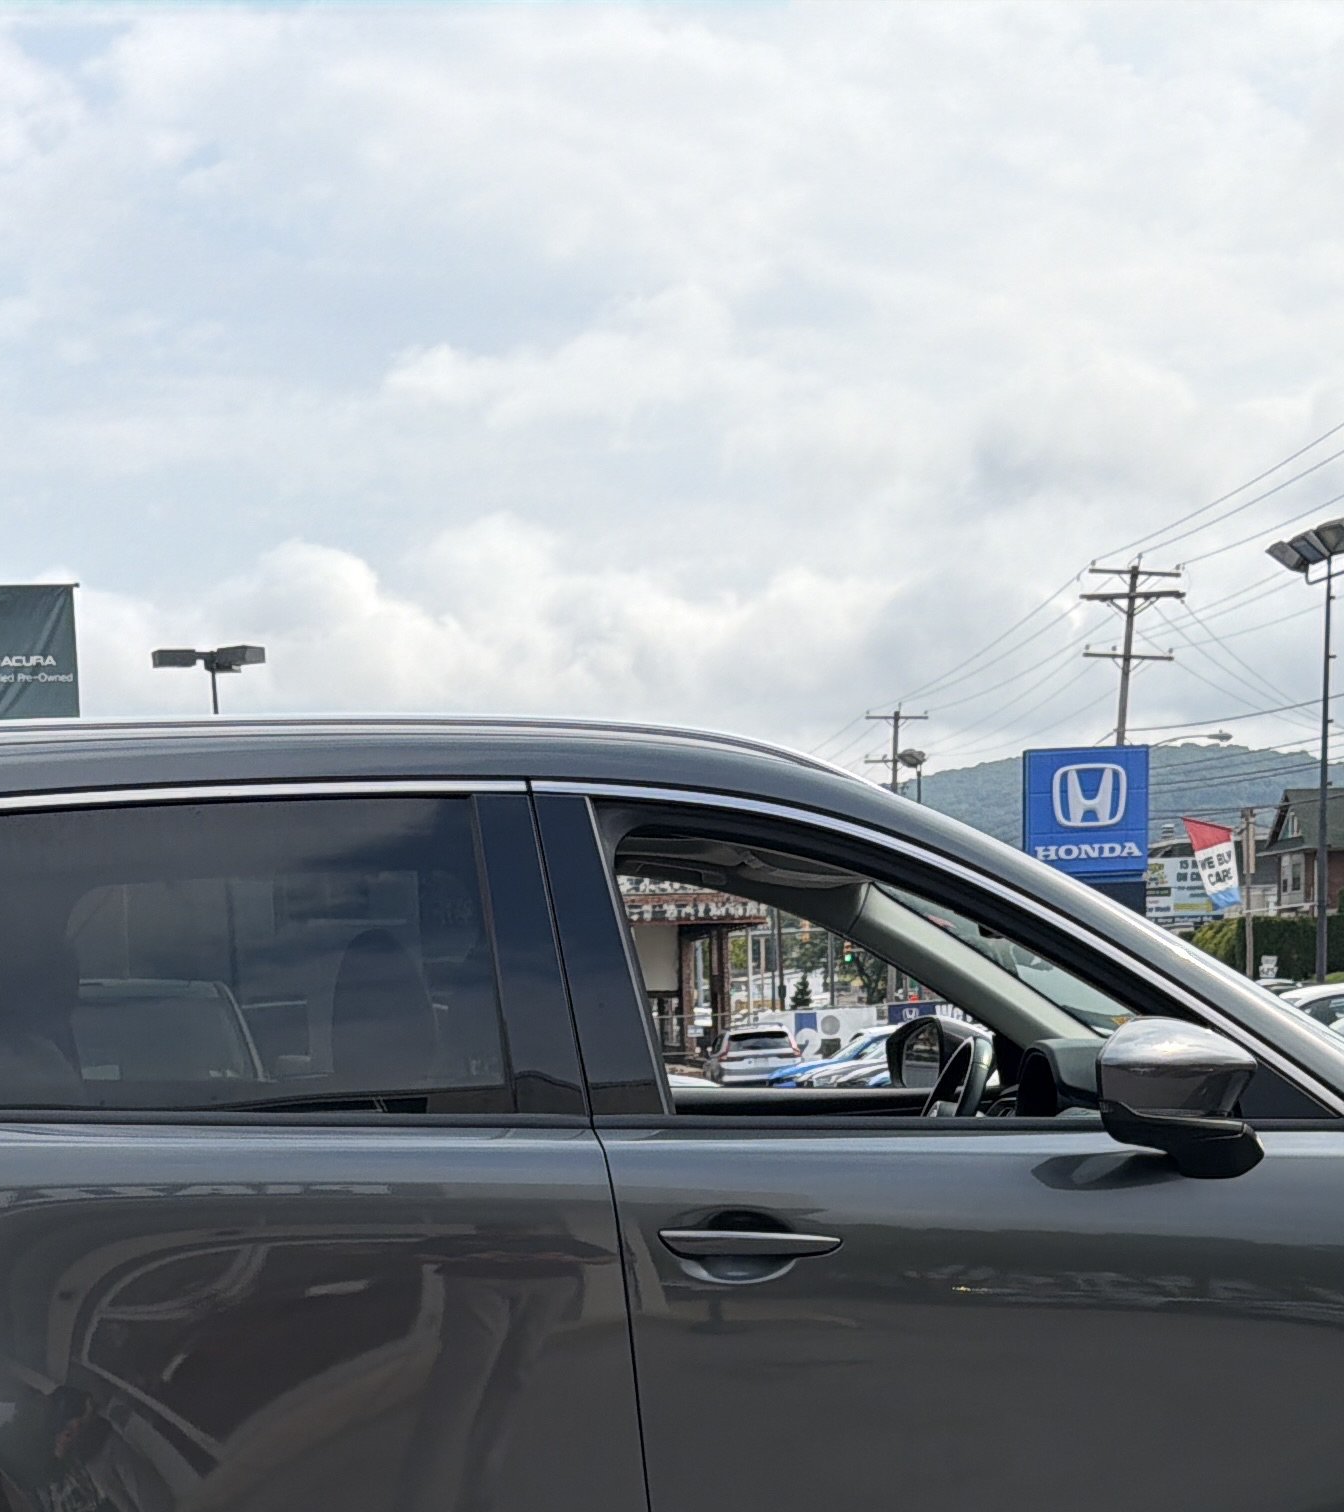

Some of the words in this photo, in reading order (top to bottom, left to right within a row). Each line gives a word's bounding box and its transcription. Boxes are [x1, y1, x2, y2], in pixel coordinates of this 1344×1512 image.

[0, 655, 57, 667] ACURA
[17, 671, 74, 683] Pre-Owned
[1034, 842, 1143, 861] HONDA
